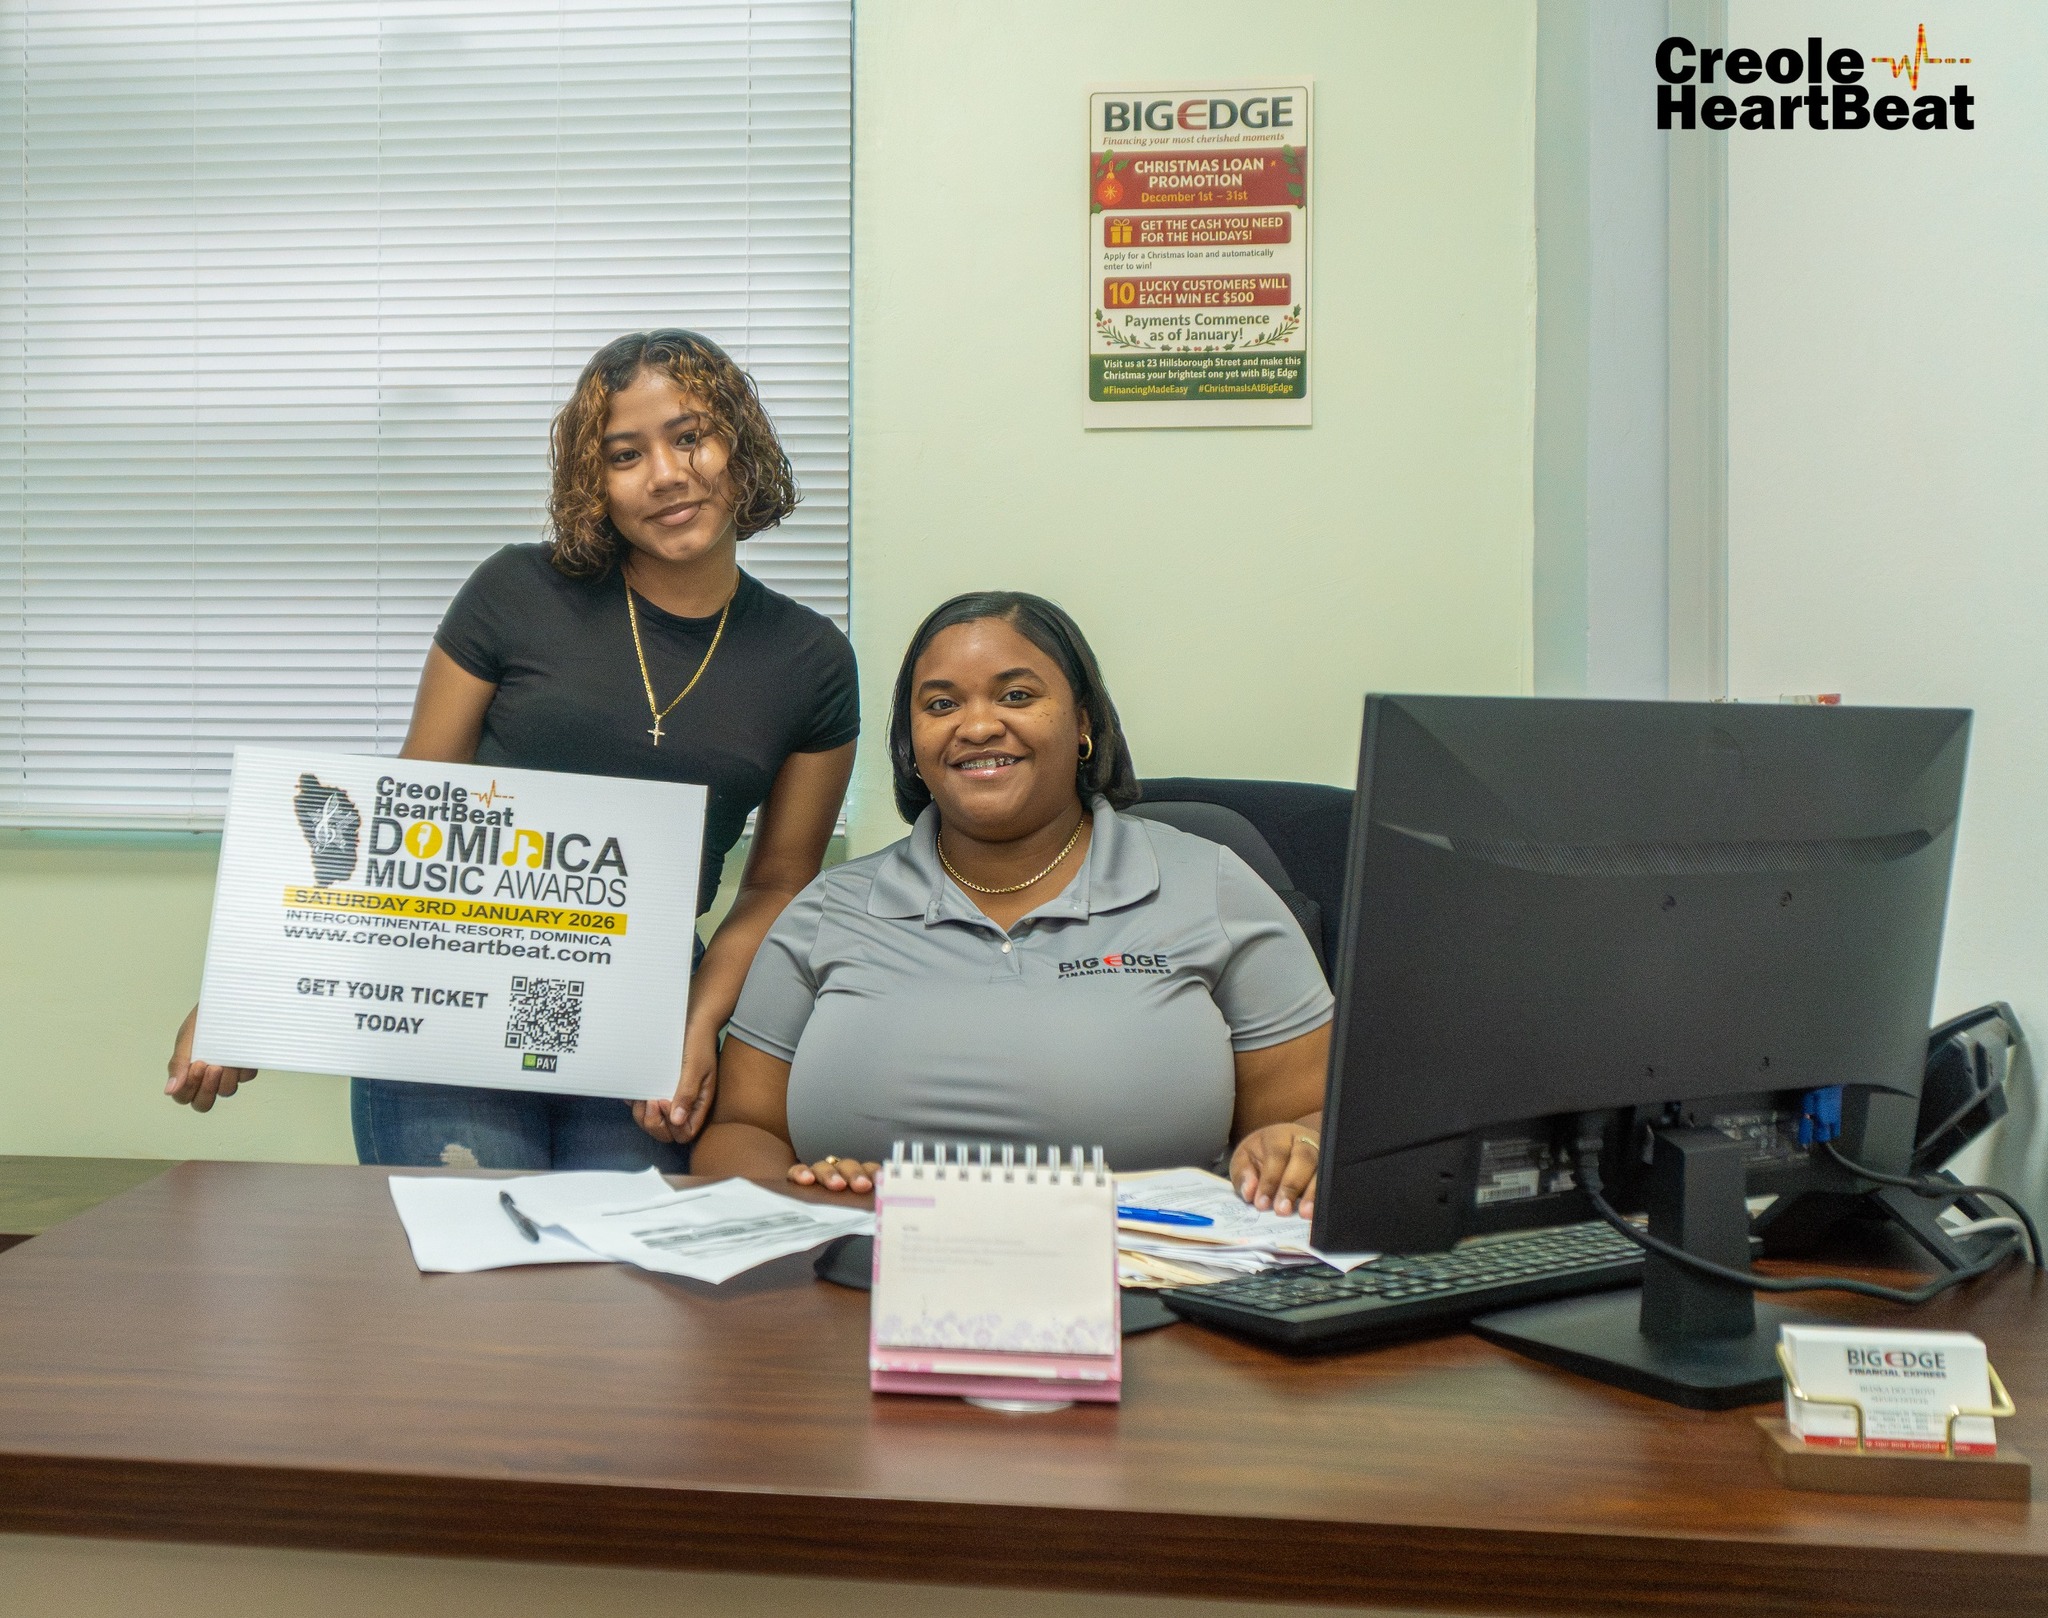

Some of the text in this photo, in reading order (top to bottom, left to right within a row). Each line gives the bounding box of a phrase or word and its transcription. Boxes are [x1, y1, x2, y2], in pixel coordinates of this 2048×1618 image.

[1103, 133, 1285, 146] Financing your most cherished moments
[1134, 158, 1264, 173] CHRISTMAS LOAN
[1149, 174, 1243, 188] PROMOTION
[1141, 191, 1195, 203] December
[1198, 191, 1213, 201] 1st
[1226, 190, 1248, 200] 31st
[1141, 217, 1283, 230] GET THE CASH YOU NEED
[1141, 230, 1252, 242] FOR THE HOLIDAYS!
[1104, 252, 1125, 261] Apply
[1128, 252, 1138, 260] for
[1147, 251, 1185, 259] Christmas
[1187, 250, 1203, 258] loan
[1222, 249, 1274, 258] automatically
[1139, 278, 1288, 292] LUCKY CUSTOMERS WILL
[1109, 282, 1135, 305] 10
[1139, 292, 1254, 305] EACH WIN EC $500
[1125, 313, 1270, 329] Payments Commence
[1150, 328, 1243, 343] as of January!
[1104, 359, 1123, 368] Visit
[1147, 359, 1157, 367] 23
[1159, 358, 1213, 368] Hillsborough
[1215, 358, 1241, 366] Street
[1242, 357, 1259, 366] and
[1261, 357, 1283, 365] make
[1285, 356, 1301, 365] this
[1104, 368, 1297, 380] Christmas your brightest one yet with Big Edge
[1103, 383, 1293, 396] #FinancingMadeEasy #ChristmasIsAtBigEdge
[376, 776, 468, 803] Creole
[374, 795, 514, 828] HeartBeat
[368, 816, 628, 878] DOMINICA
[364, 858, 627, 908] MUSIC AWARDS
[295, 889, 615, 930] SATURDAY 3RD JANUARY 2026
[286, 910, 612, 946] INTERCONTINENTAL RESORT, DOMINICA
[284, 926, 612, 965] www.creoleheartbeat.com
[1058, 968, 1120, 979] FINANCIAL
[297, 977, 489, 1009] GET YOUR TICKET
[354, 1013, 425, 1035] TODAY
[536, 1058, 556, 1069] PAY
[1849, 1368, 1946, 1379] FINANCIAL EXPRESS
